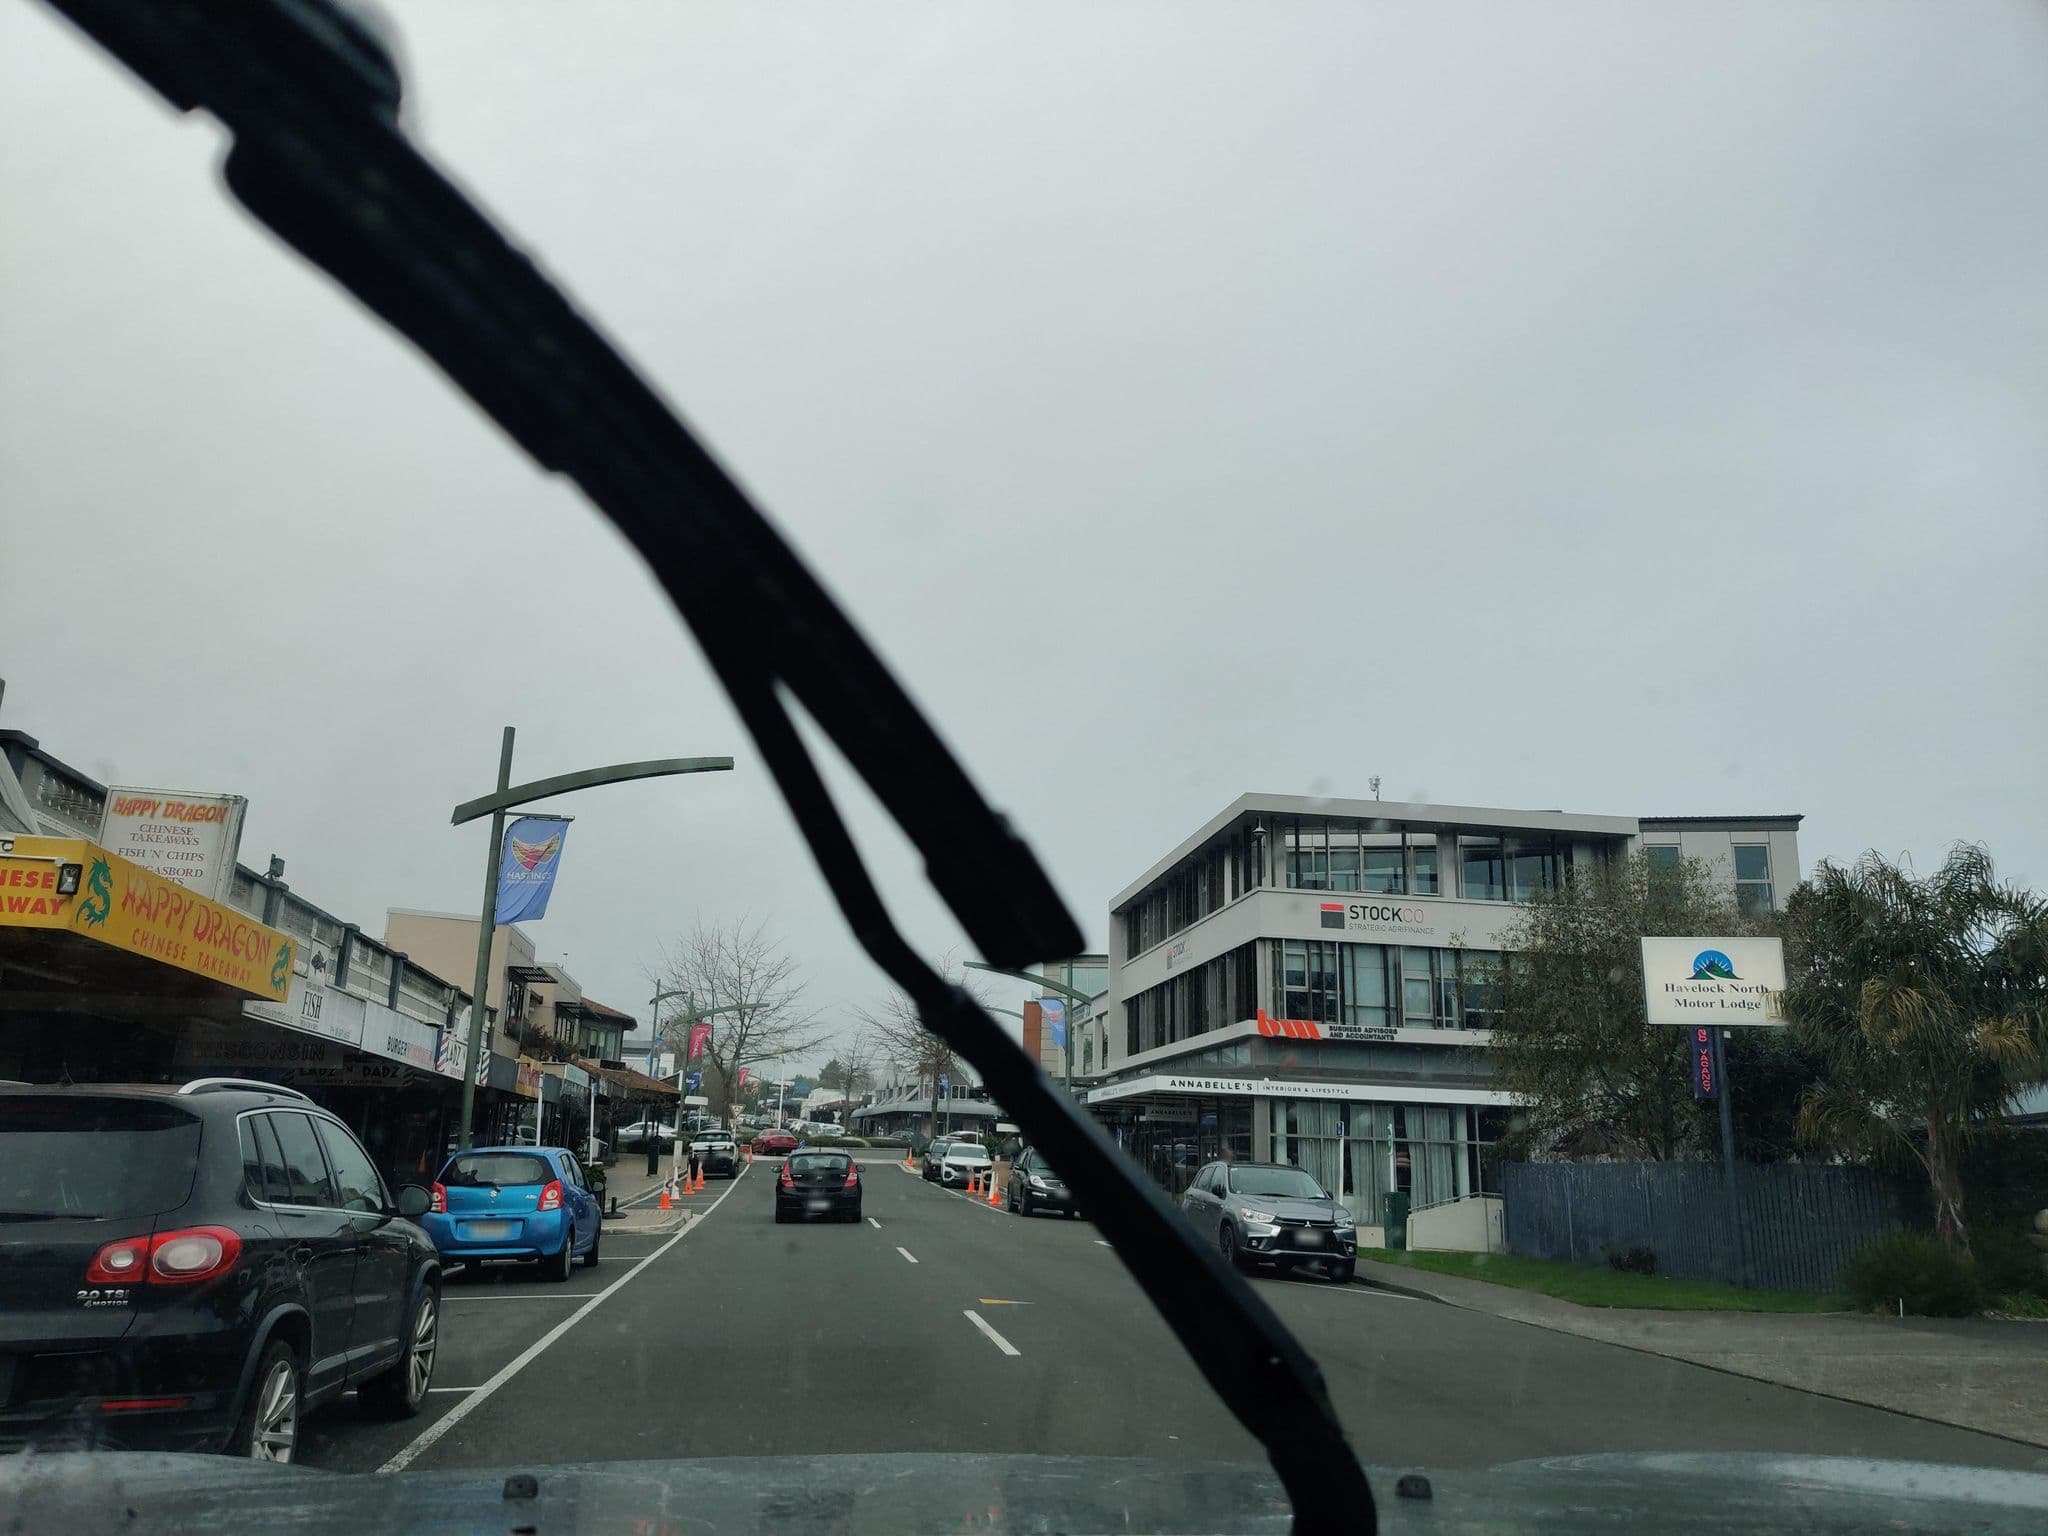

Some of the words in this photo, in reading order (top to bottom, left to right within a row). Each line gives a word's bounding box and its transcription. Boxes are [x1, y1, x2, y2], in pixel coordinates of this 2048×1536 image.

[112, 797, 161, 819] HAPPY
[162, 800, 228, 825] DRAGON
[139, 824, 194, 836] CHINESE
[130, 832, 200, 846] TAKEAWAYS
[118, 848, 146, 858] FISH
[167, 851, 205, 862] CHIPS
[508, 872, 552, 881] HASTINGS
[121, 874, 193, 932] HAPPY
[193, 904, 271, 965] DRAGON
[1350, 905, 1424, 924] STOCKCO
[1349, 923, 1386, 933] STRATEGIC
[1388, 925, 1436, 936] AGRIFINANCE
[132, 930, 188, 961] CHINESE
[196, 952, 251, 982] TAKEAWAY
[1665, 983, 1725, 994] Havelock
[1730, 984, 1769, 994] North
[302, 991, 323, 1019] FISH
[1674, 999, 1716, 1009] Motor
[1720, 999, 1761, 1011] Lodge
[1328, 1025, 1362, 1033] BUSINESS
[1364, 1026, 1398, 1035] ADVISORS
[1697, 1029, 1708, 1042] NO
[1346, 1033, 1395, 1041] ACCOUNTANTS
[1700, 1048, 1711, 1092] VACANCY
[1170, 1079, 1254, 1091] ANNABELLE'S
[1263, 1085, 1302, 1093] INTERIORS
[1311, 1087, 1350, 1095] LIFESTYLE
[84, 1300, 129, 1308] 4MOTION
